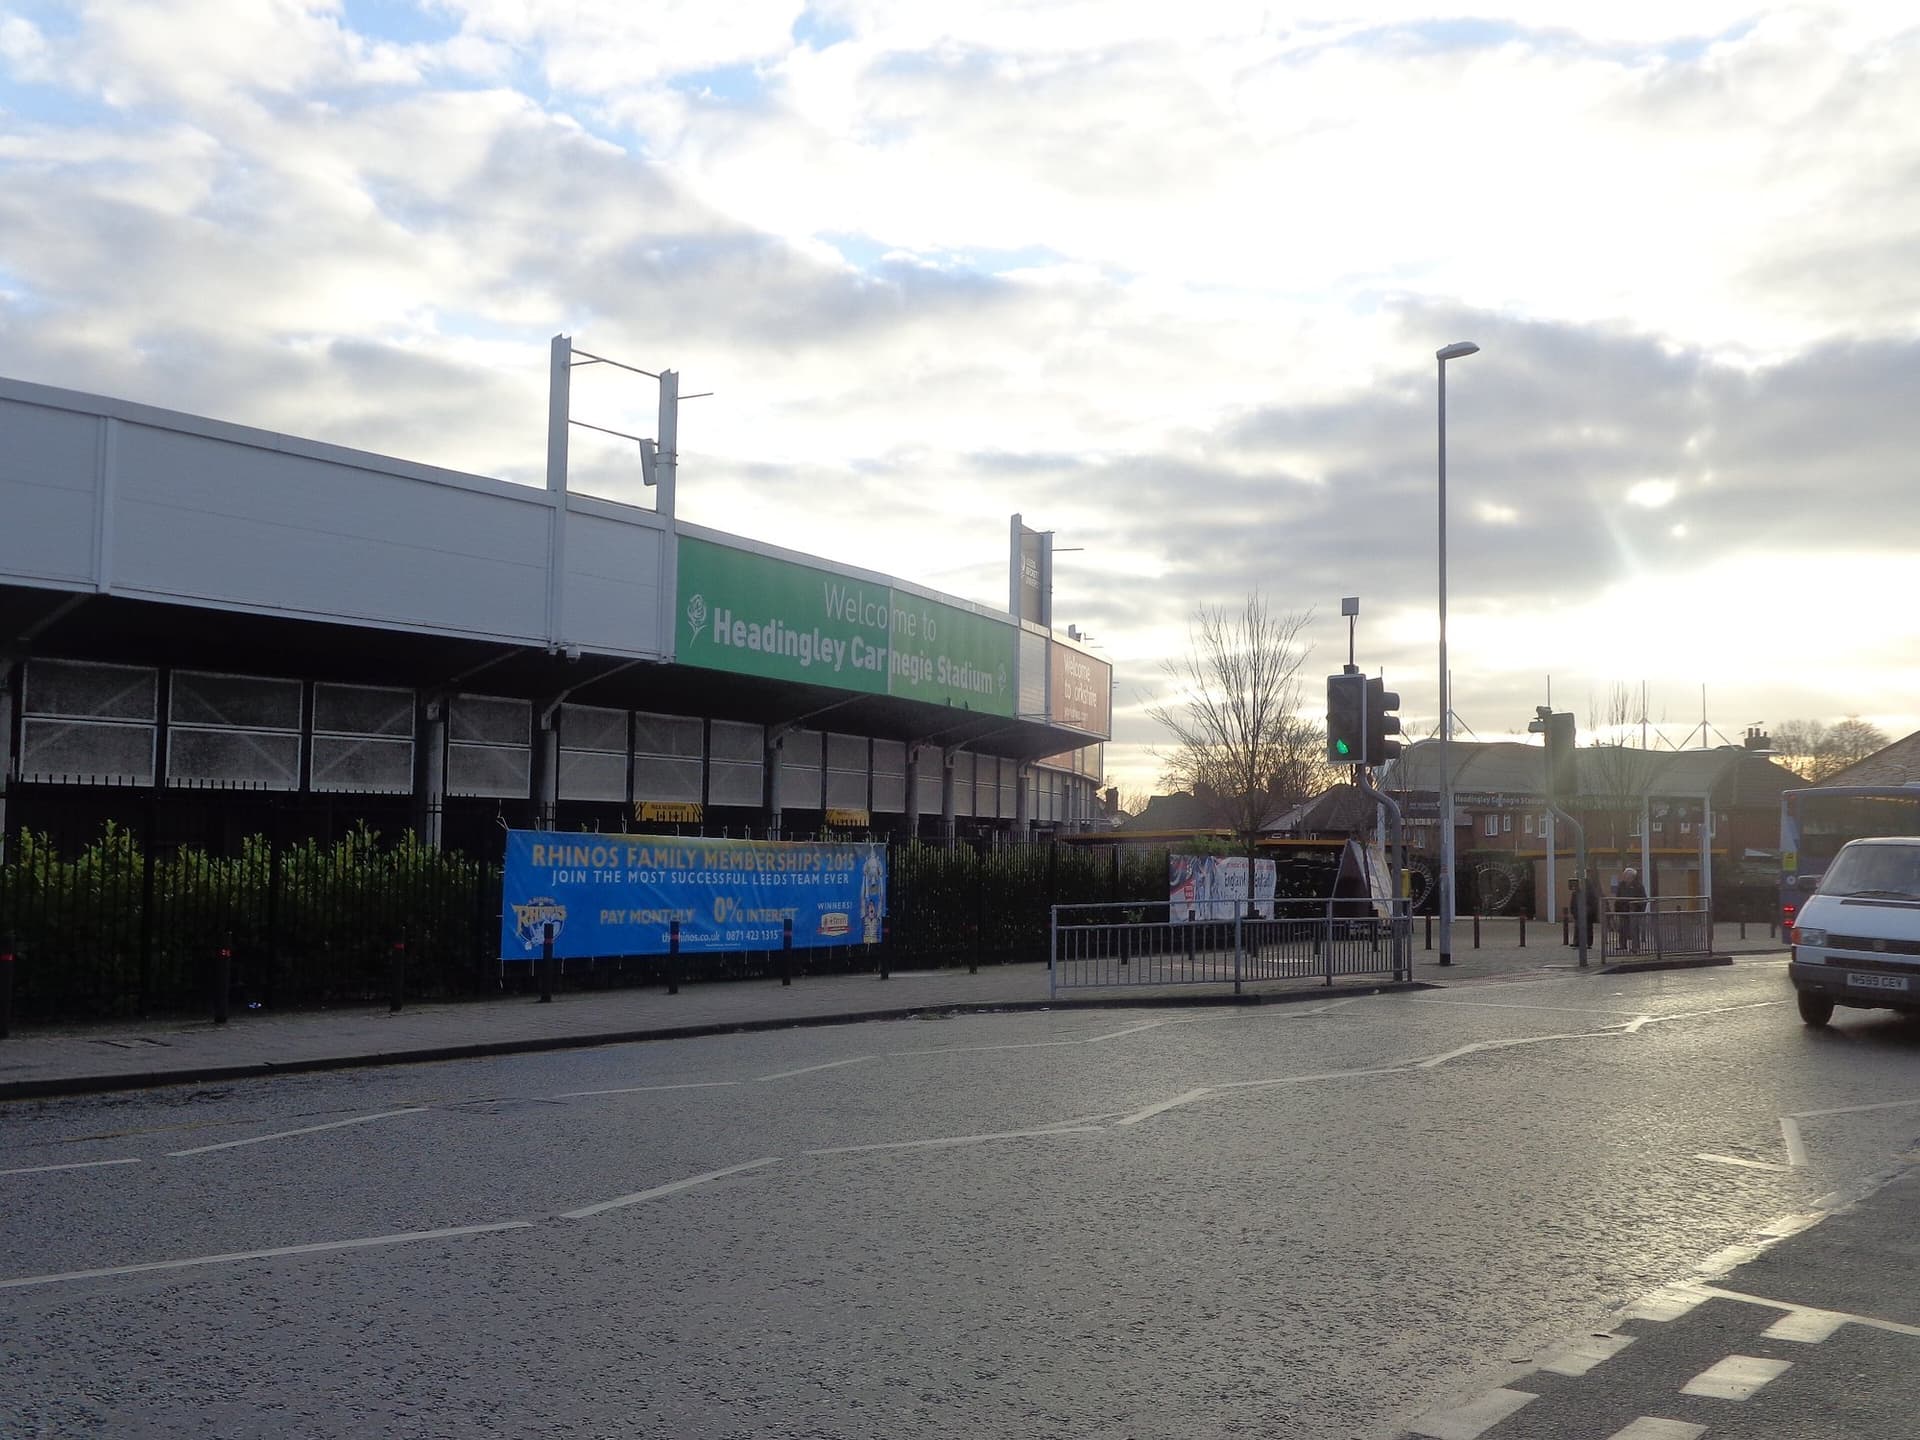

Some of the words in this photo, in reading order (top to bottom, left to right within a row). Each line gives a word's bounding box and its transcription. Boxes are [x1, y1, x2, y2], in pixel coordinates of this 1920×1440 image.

[824, 582, 916, 638] Welcome
[922, 611, 937, 642] to
[714, 607, 847, 671] Headingley
[851, 636, 933, 685] Carnegie
[937, 655, 993, 695] Stadium
[1063, 653, 1091, 682] Welcome
[1064, 679, 1071, 700] to
[1073, 682, 1097, 707] orkshire
[532, 844, 619, 867] RHINOS
[627, 847, 697, 869] FAMILY
[704, 850, 821, 872] MEMBERSHIPS
[826, 852, 855, 871] 2015
[552, 870, 587, 886] JOIN
[593, 870, 621, 883] THE
[628, 871, 665, 884] MOST
[671, 872, 748, 885] SUCCESSFUL
[752, 873, 787, 885] LEEDS
[791, 873, 819, 885] TEAM
[824, 873, 849, 885] EVER
[599, 909, 625, 925] PAY
[630, 908, 695, 925] MONTHLY
[714, 896, 743, 923] 0%
[747, 907, 797, 923] INTEREST
[662, 930, 720, 943] thhinos.co.uk
[726, 930, 744, 941] 0871
[746, 930, 760, 941] 423
[761, 930, 778, 940] 1315
